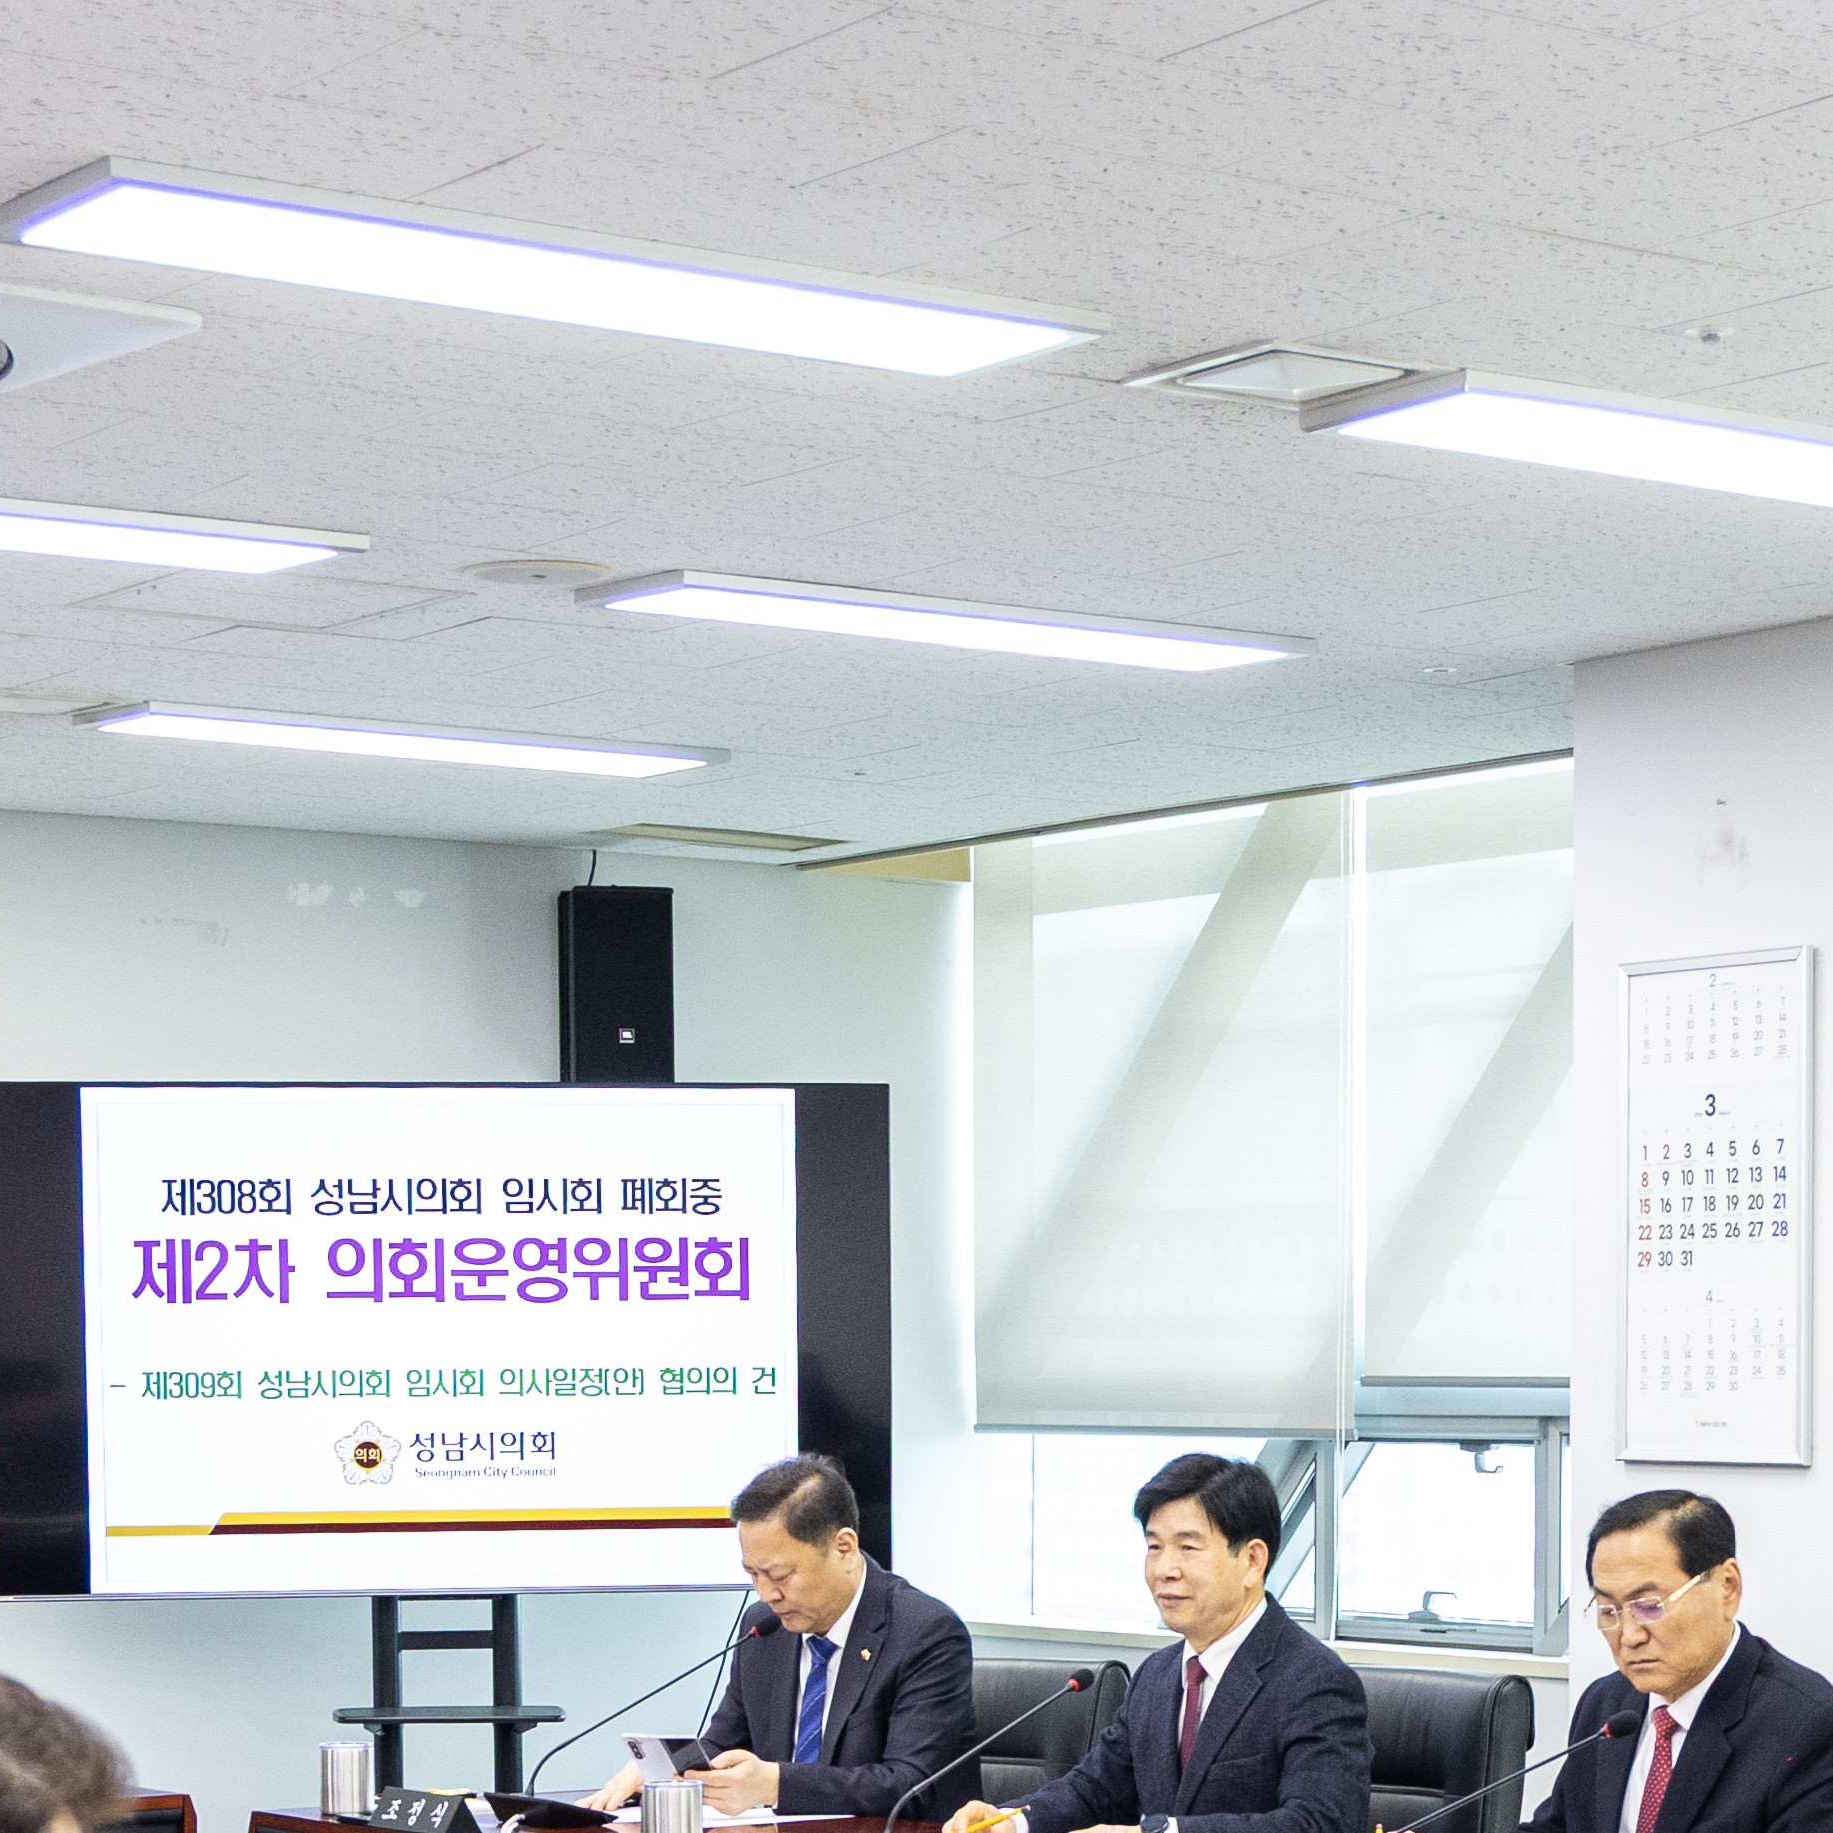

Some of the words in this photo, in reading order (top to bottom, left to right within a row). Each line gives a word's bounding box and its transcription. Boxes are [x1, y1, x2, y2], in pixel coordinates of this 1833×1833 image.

[1709, 973, 1717, 988] 2
[1704, 1093, 1717, 1117] 3
[1642, 1144, 1648, 1161] 1
[1662, 1143, 1670, 1160] 2
[1683, 1142, 1692, 1159] 3
[1705, 1141, 1715, 1157] 4
[1728, 1140, 1737, 1157] 5
[1751, 1139, 1761, 1156] 6
[1776, 1138, 1785, 1154] 7
[1641, 1171, 1649, 1188] 8
[1662, 1170, 1670, 1187] 9
[1681, 1169, 1695, 1186] 10
[1704, 1168, 1714, 1185] 11
[1726, 1167, 1739, 1184] 12
[1748, 1166, 1763, 1183] 13
[1773, 1165, 1787, 1182] 14
[162, 1179, 291, 1215] 제308회
[311, 1178, 481, 1216] 성남시의회
[503, 1178, 602, 1214] 임시회
[621, 1178, 722, 1215] 폐회중
[1639, 1198, 1651, 1215] 15
[1660, 1197, 1673, 1214] 16
[1681, 1196, 1694, 1213] 17
[1703, 1195, 1717, 1212] 18
[1725, 1194, 1740, 1212] 19
[1747, 1193, 1765, 1211] 20
[1773, 1192, 1786, 1210] 21
[1638, 1224, 1653, 1241] 22
[1658, 1223, 1673, 1240] 23
[1679, 1223, 1696, 1240] 24
[1701, 1222, 1718, 1239] 25
[1724, 1221, 1741, 1238] 26
[1747, 1221, 1764, 1238] 27
[1771, 1220, 1789, 1237] 28
[132, 1239, 295, 1304] 제2차
[327, 1237, 749, 1303] 의회운영위원회
[1637, 1251, 1652, 1268] 29
[1657, 1250, 1674, 1267] 30
[1680, 1250, 1693, 1267] 31
[1705, 1289, 1713, 1303] 4
[142, 1371, 241, 1400] 제309회
[258, 1370, 390, 1399] 성남시의회
[407, 1369, 484, 1397] 임시회
[660, 1367, 736, 1395] 협의의
[752, 1367, 775, 1394] 건
[355, 1448, 381, 1463] 의회
[410, 1432, 555, 1462] 성남시의회
[415, 1467, 480, 1480] Seongnam
[484, 1466, 508, 1479] City
[511, 1466, 556, 1477] Council
[381, 1798, 449, 1828] 조정식
